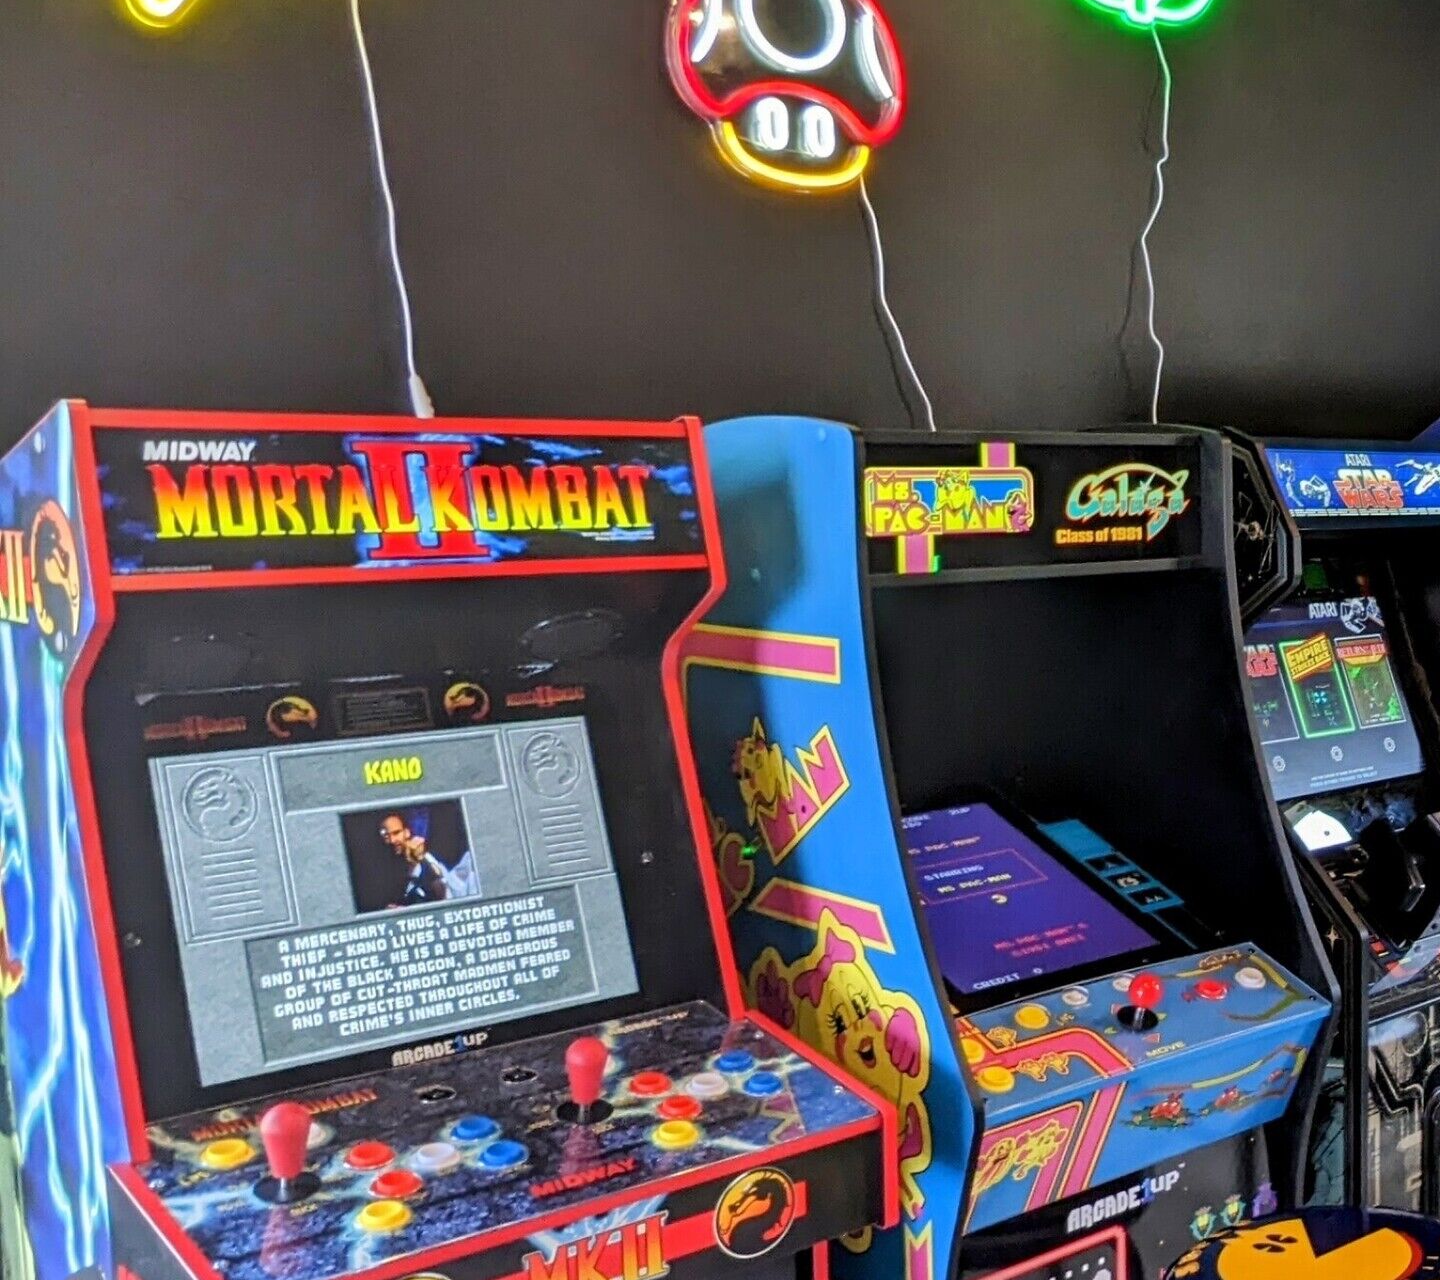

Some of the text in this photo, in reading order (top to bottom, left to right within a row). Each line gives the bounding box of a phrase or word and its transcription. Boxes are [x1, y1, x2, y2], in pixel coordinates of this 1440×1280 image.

[143, 440, 257, 462] MIDWAY
[1345, 453, 1373, 467] ATARI
[1332, 480, 1404, 509] WARS
[1337, 468, 1393, 487] STAR
[146, 463, 652, 539] MORTAL KOMBAT
[870, 498, 1008, 533] PAC-MAN
[1055, 525, 1143, 545] Class of 1981
[1308, 601, 1338, 619] ATARI
[1286, 639, 1329, 667] EMPIRE
[363, 755, 424, 786] KANO
[278, 896, 545, 954] A MERCENARY, THUG, EXTORTIONIST
[280, 948, 327, 969] THIEF
[346, 938, 388, 957] KANO
[392, 930, 435, 949] LIVES
[439, 927, 450, 940] A
[453, 921, 486, 938] LIFE
[489, 918, 509, 930] OF
[512, 908, 556, 927] CRIME
[259, 919, 575, 989] AND INJUSTICE. HE IS A DEVOTED MEMBER
[284, 937, 559, 1000] OF THE BLACK DRAGON, A DANGEROUS
[273, 948, 571, 1018] GROUP OF CUT-THROAT MADMEN FEARED
[291, 966, 561, 1030] AND RESPECTED THROUGHOUT ALL OF
[972, 972, 1021, 990] CREDIT
[339, 988, 521, 1037] CRIME'S INNER CIRCLES.
[391, 1031, 489, 1068] ARCADE1UP
[1145, 1041, 1187, 1057] MOVE
[529, 1157, 638, 1198] MIDWAY
[1066, 1170, 1180, 1233] ARCADE1UP
